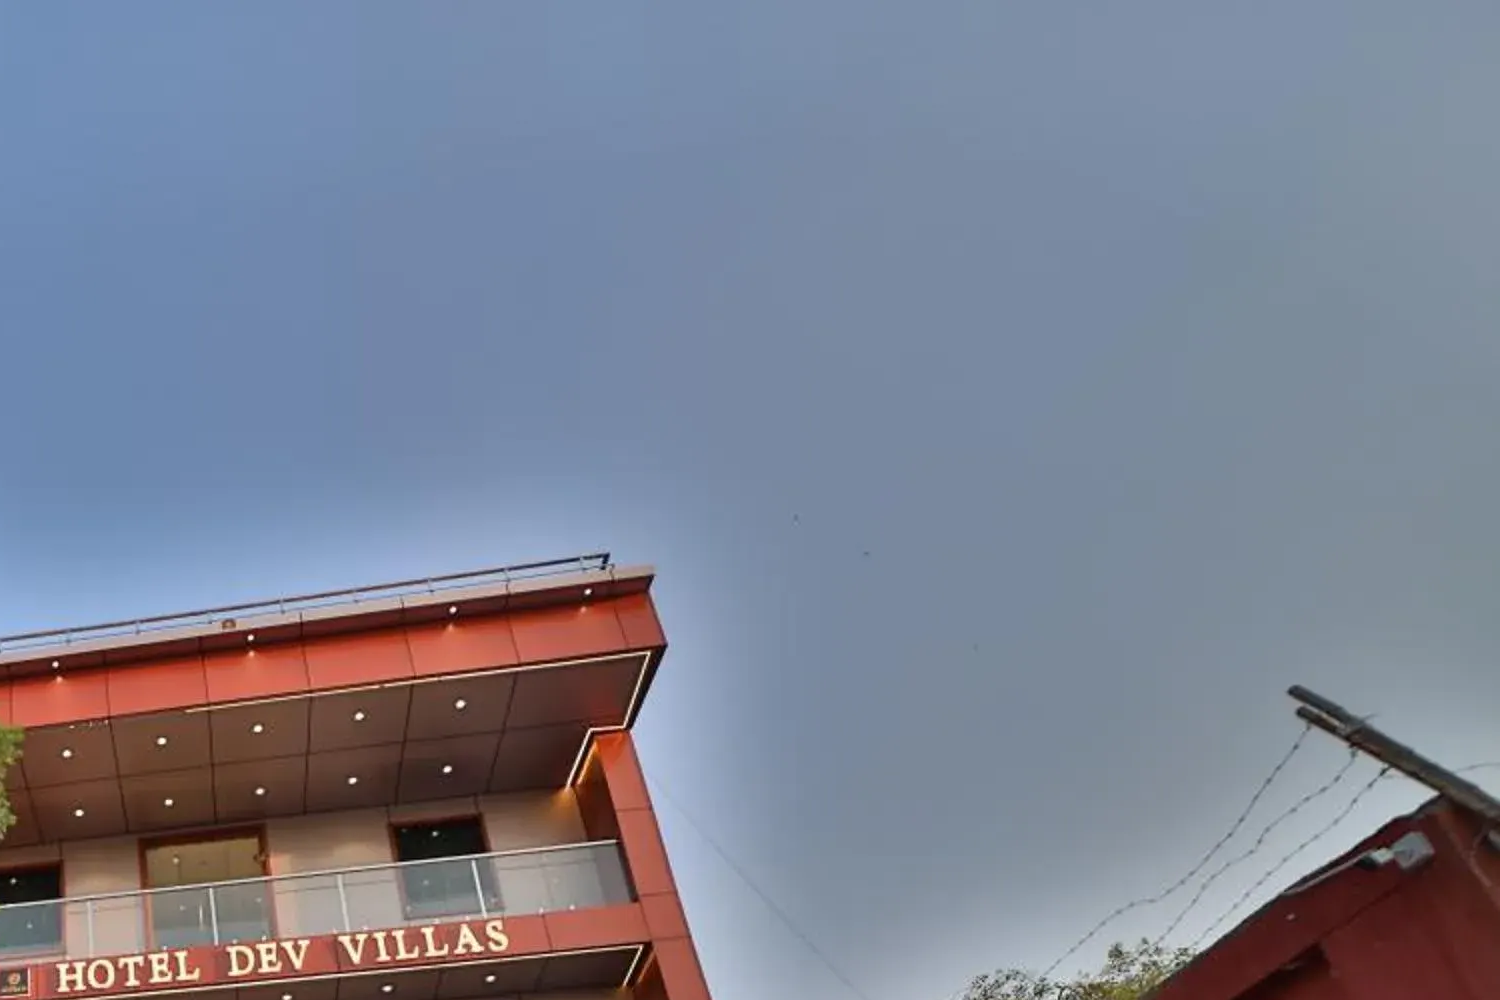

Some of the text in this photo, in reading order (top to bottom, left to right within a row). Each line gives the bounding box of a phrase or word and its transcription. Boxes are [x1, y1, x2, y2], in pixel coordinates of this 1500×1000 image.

[56, 919, 509, 993] HOTEL DEV VILLAS
